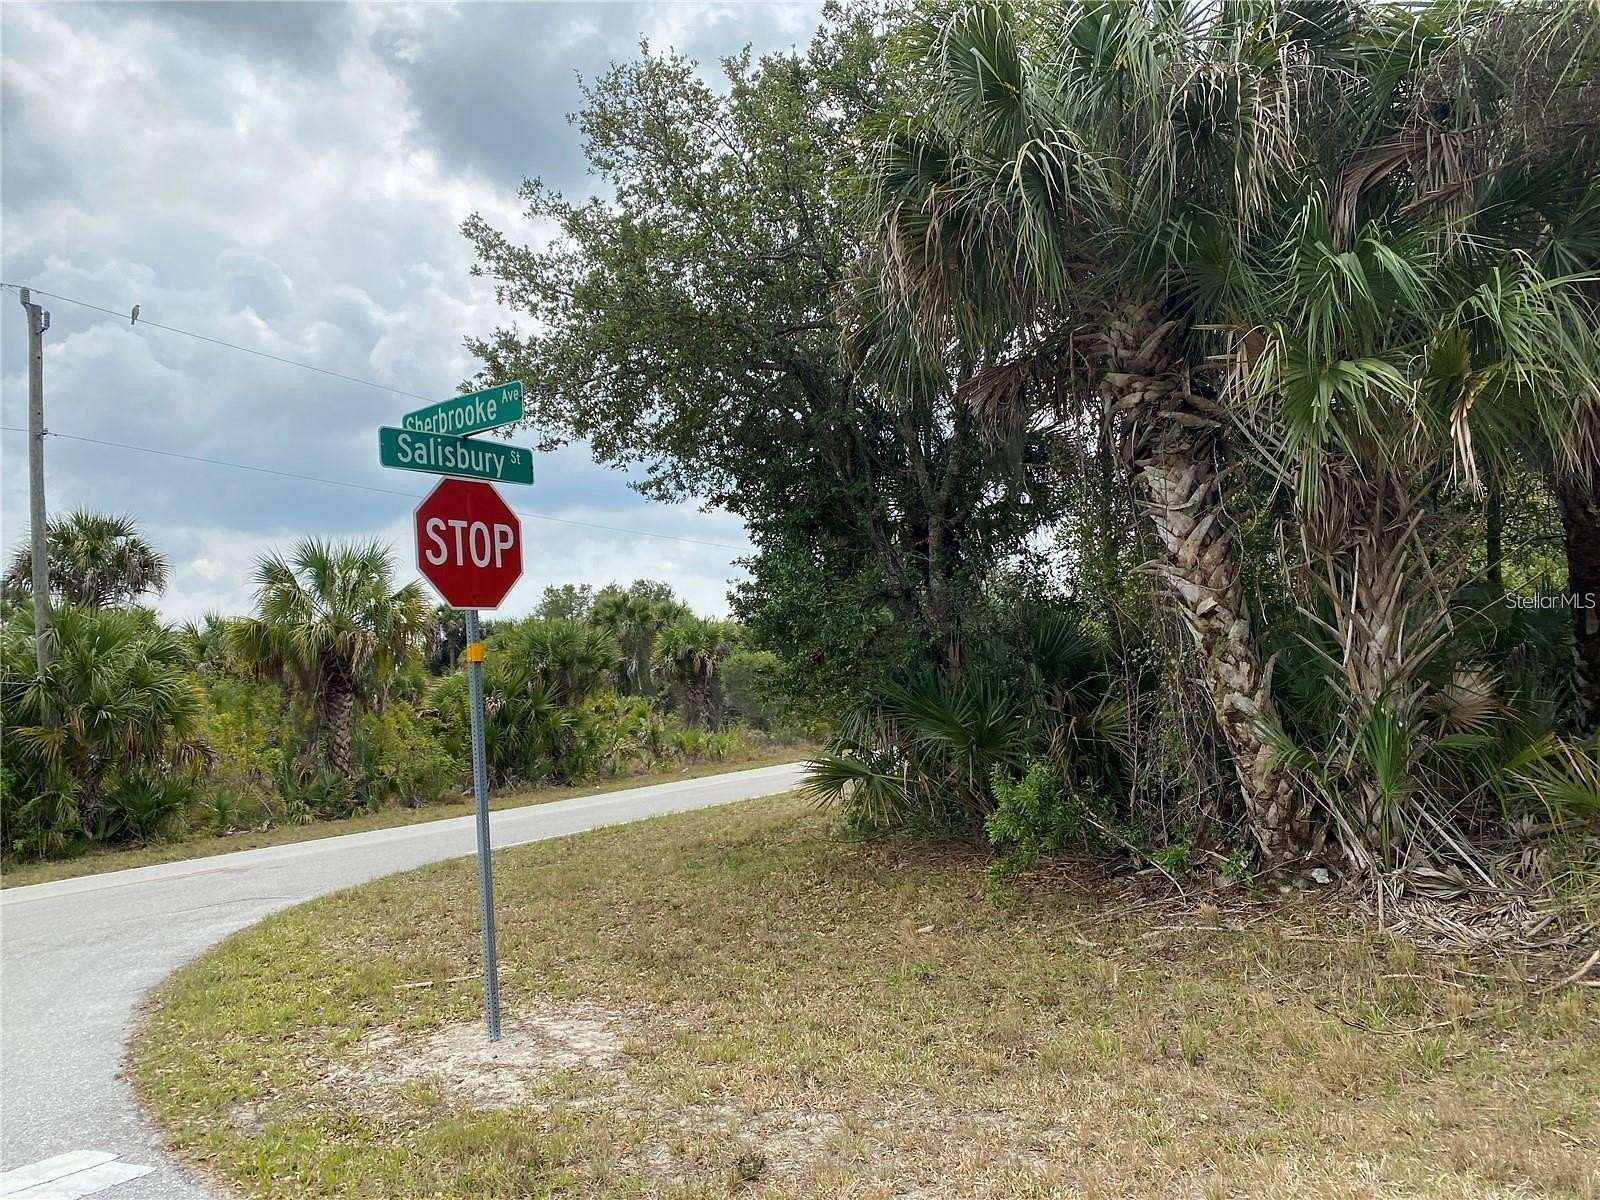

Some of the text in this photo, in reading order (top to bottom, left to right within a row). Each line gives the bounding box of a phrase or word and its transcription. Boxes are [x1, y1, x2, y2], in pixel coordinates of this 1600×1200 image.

[406, 389, 519, 433] Sherbrooke Ave
[397, 433, 521, 478] Salisbury St
[425, 517, 514, 568] STOP
